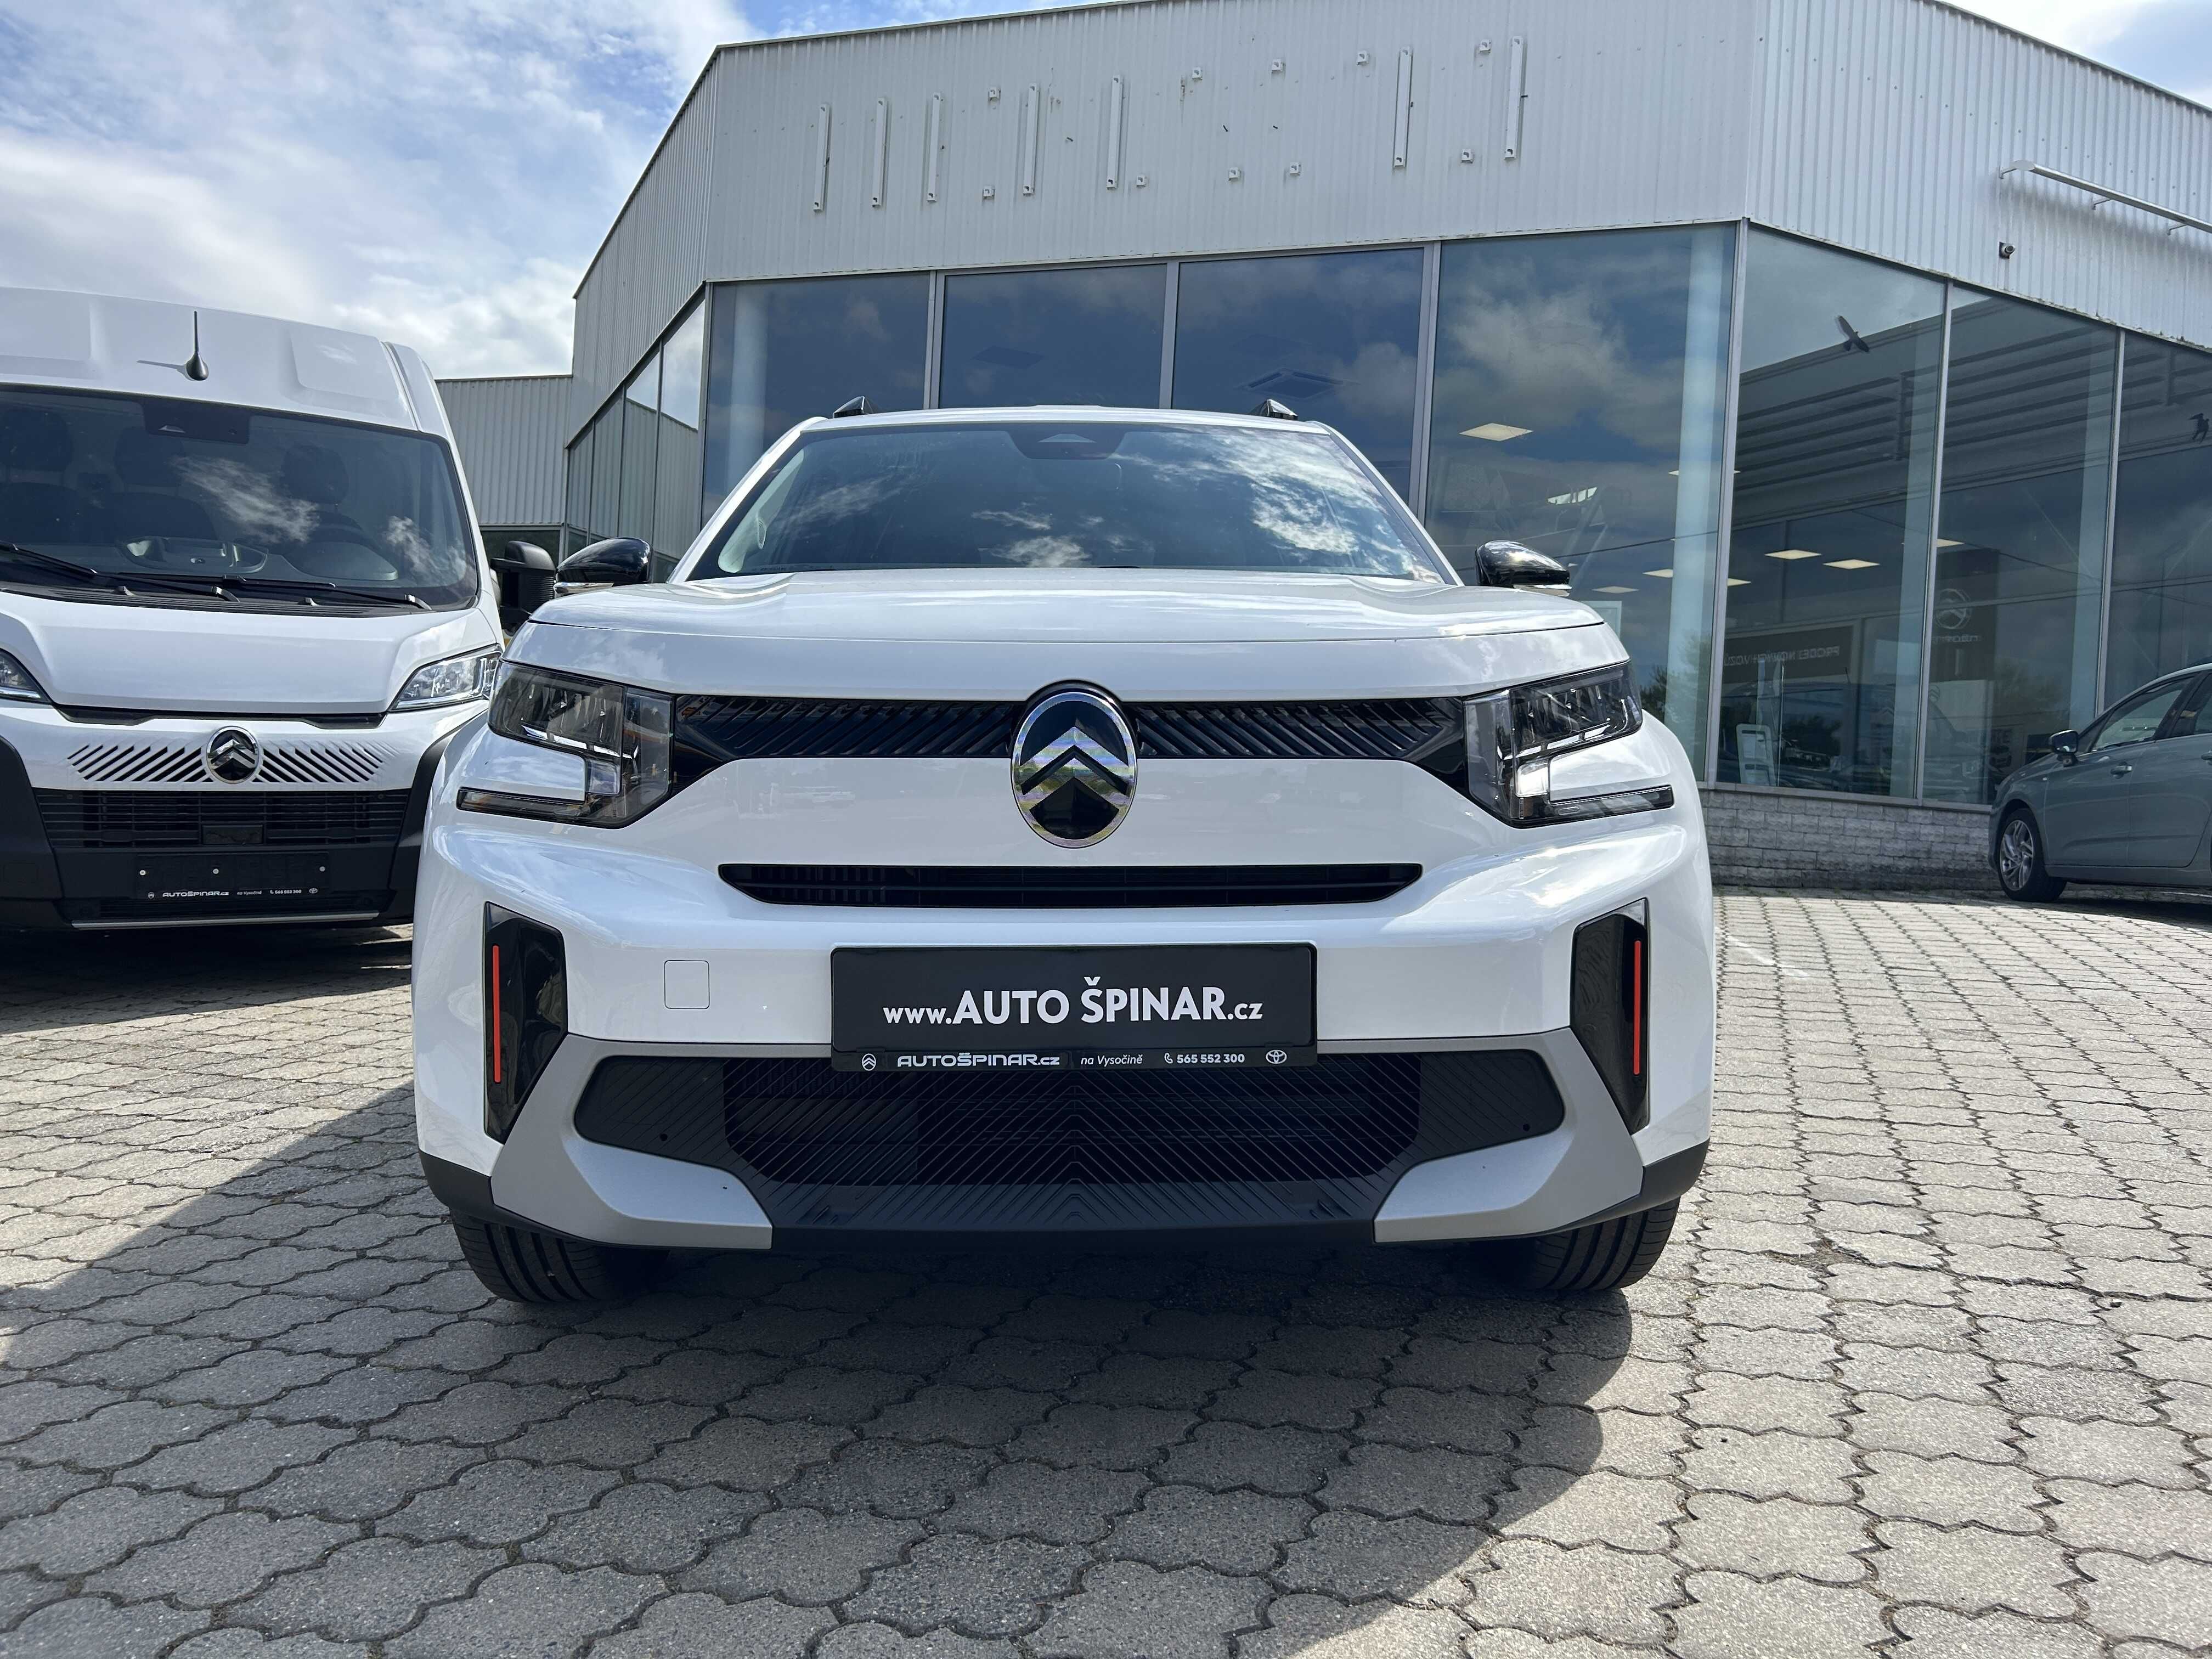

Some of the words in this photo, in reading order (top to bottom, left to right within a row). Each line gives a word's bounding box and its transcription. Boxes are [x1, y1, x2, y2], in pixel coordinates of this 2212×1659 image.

[883, 989, 1069, 1024] www.AUTO
[1081, 976, 1263, 1023] ŠPINAR.cz
[897, 1052, 1060, 1067] AUTOŠPINAR.cz
[1080, 1057, 1094, 1065] na
[1097, 1054, 1143, 1067] Vysočině
[1176, 1054, 1198, 1064] 565
[1200, 1053, 1221, 1063] 552
[1223, 1053, 1245, 1063] 300
